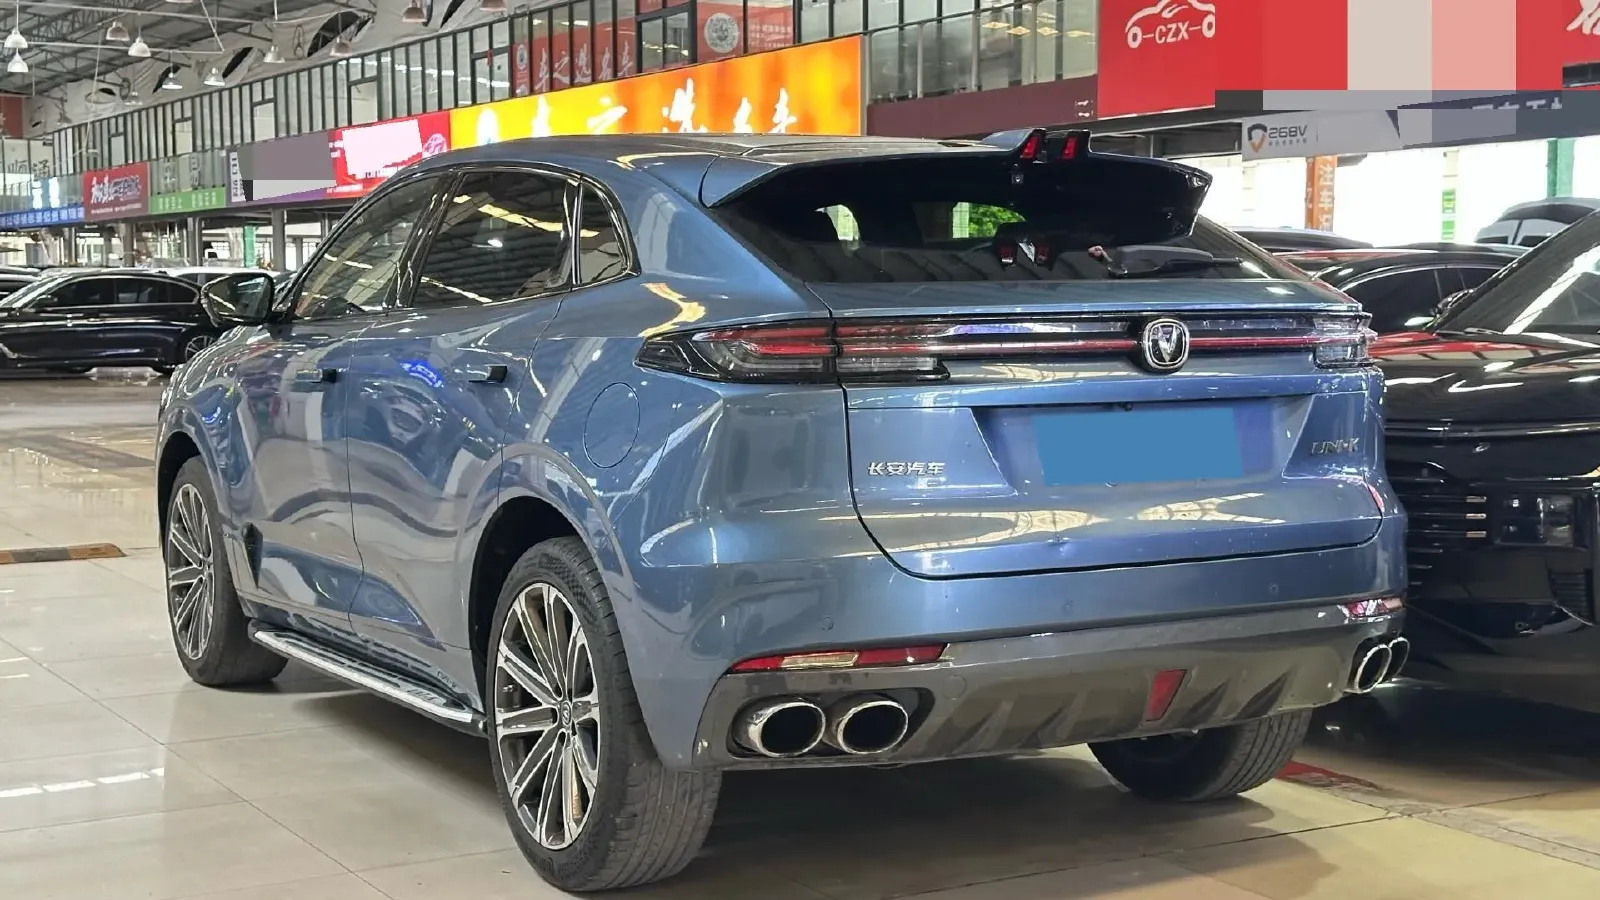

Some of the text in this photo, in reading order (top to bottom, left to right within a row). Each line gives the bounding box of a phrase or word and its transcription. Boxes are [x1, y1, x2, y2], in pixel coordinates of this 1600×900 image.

[1155, 21, 1189, 44] CZX
[1268, 124, 1308, 139] 268V
[867, 461, 946, 476] 长安汽车
